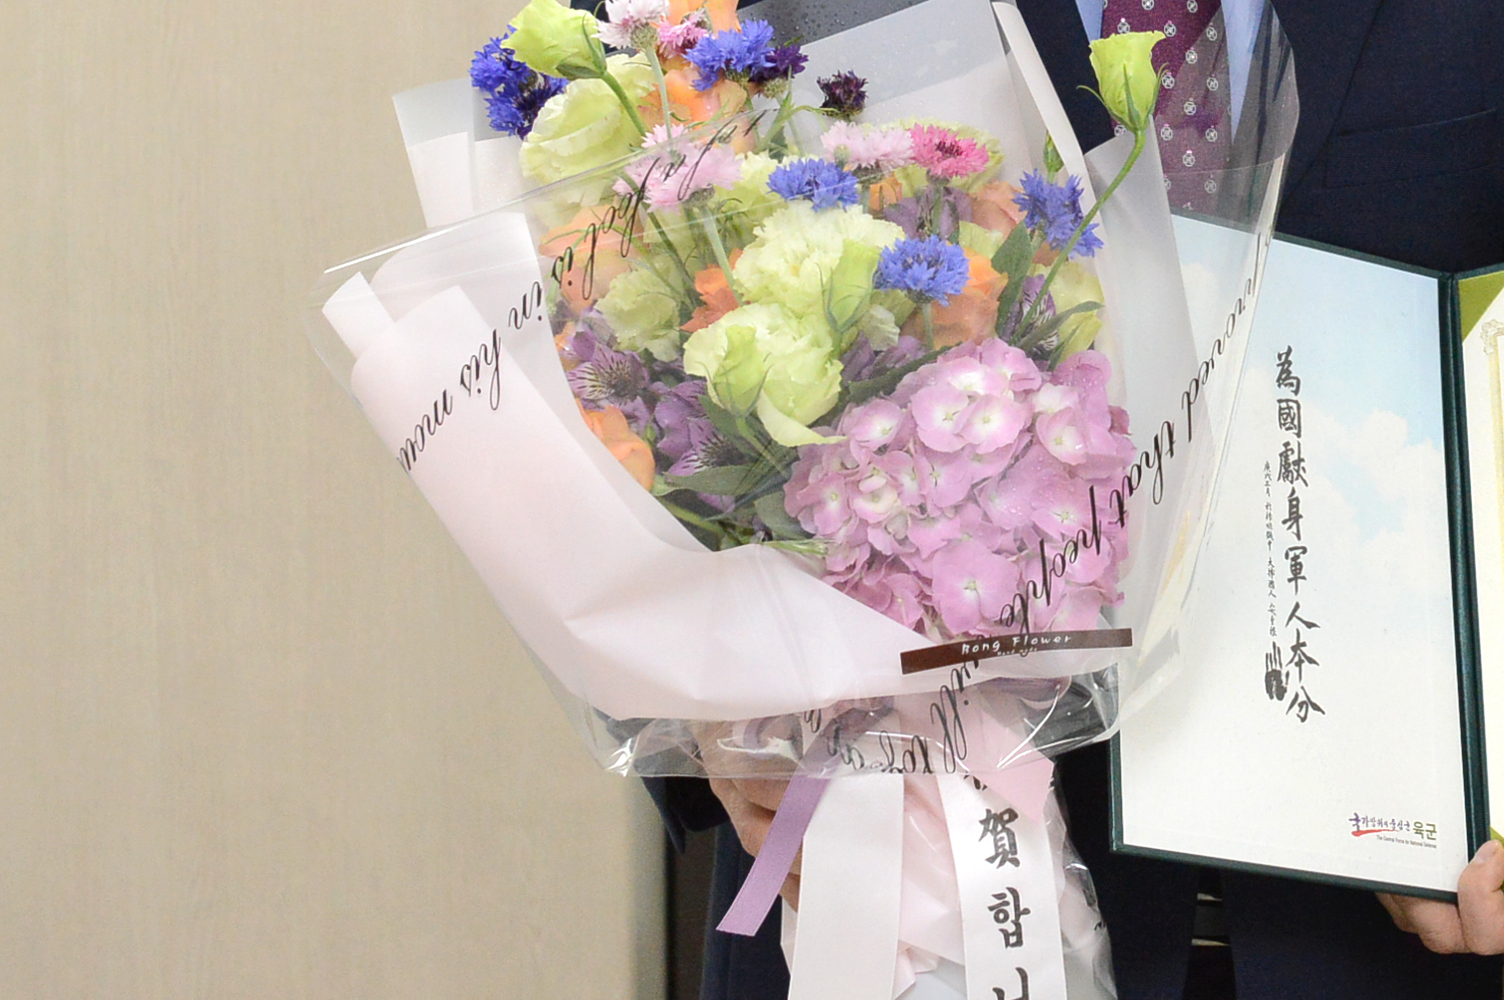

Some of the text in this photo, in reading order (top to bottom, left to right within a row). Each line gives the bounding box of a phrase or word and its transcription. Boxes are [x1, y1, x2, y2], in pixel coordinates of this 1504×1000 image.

[550, 246, 574, 288] is
[507, 280, 544, 331] in
[459, 327, 501, 411] his
[1108, 418, 1177, 529] that
[999, 484, 1102, 655] people
[1012, 635, 1072, 648] Flower
[1412, 821, 1438, 841] 육군
